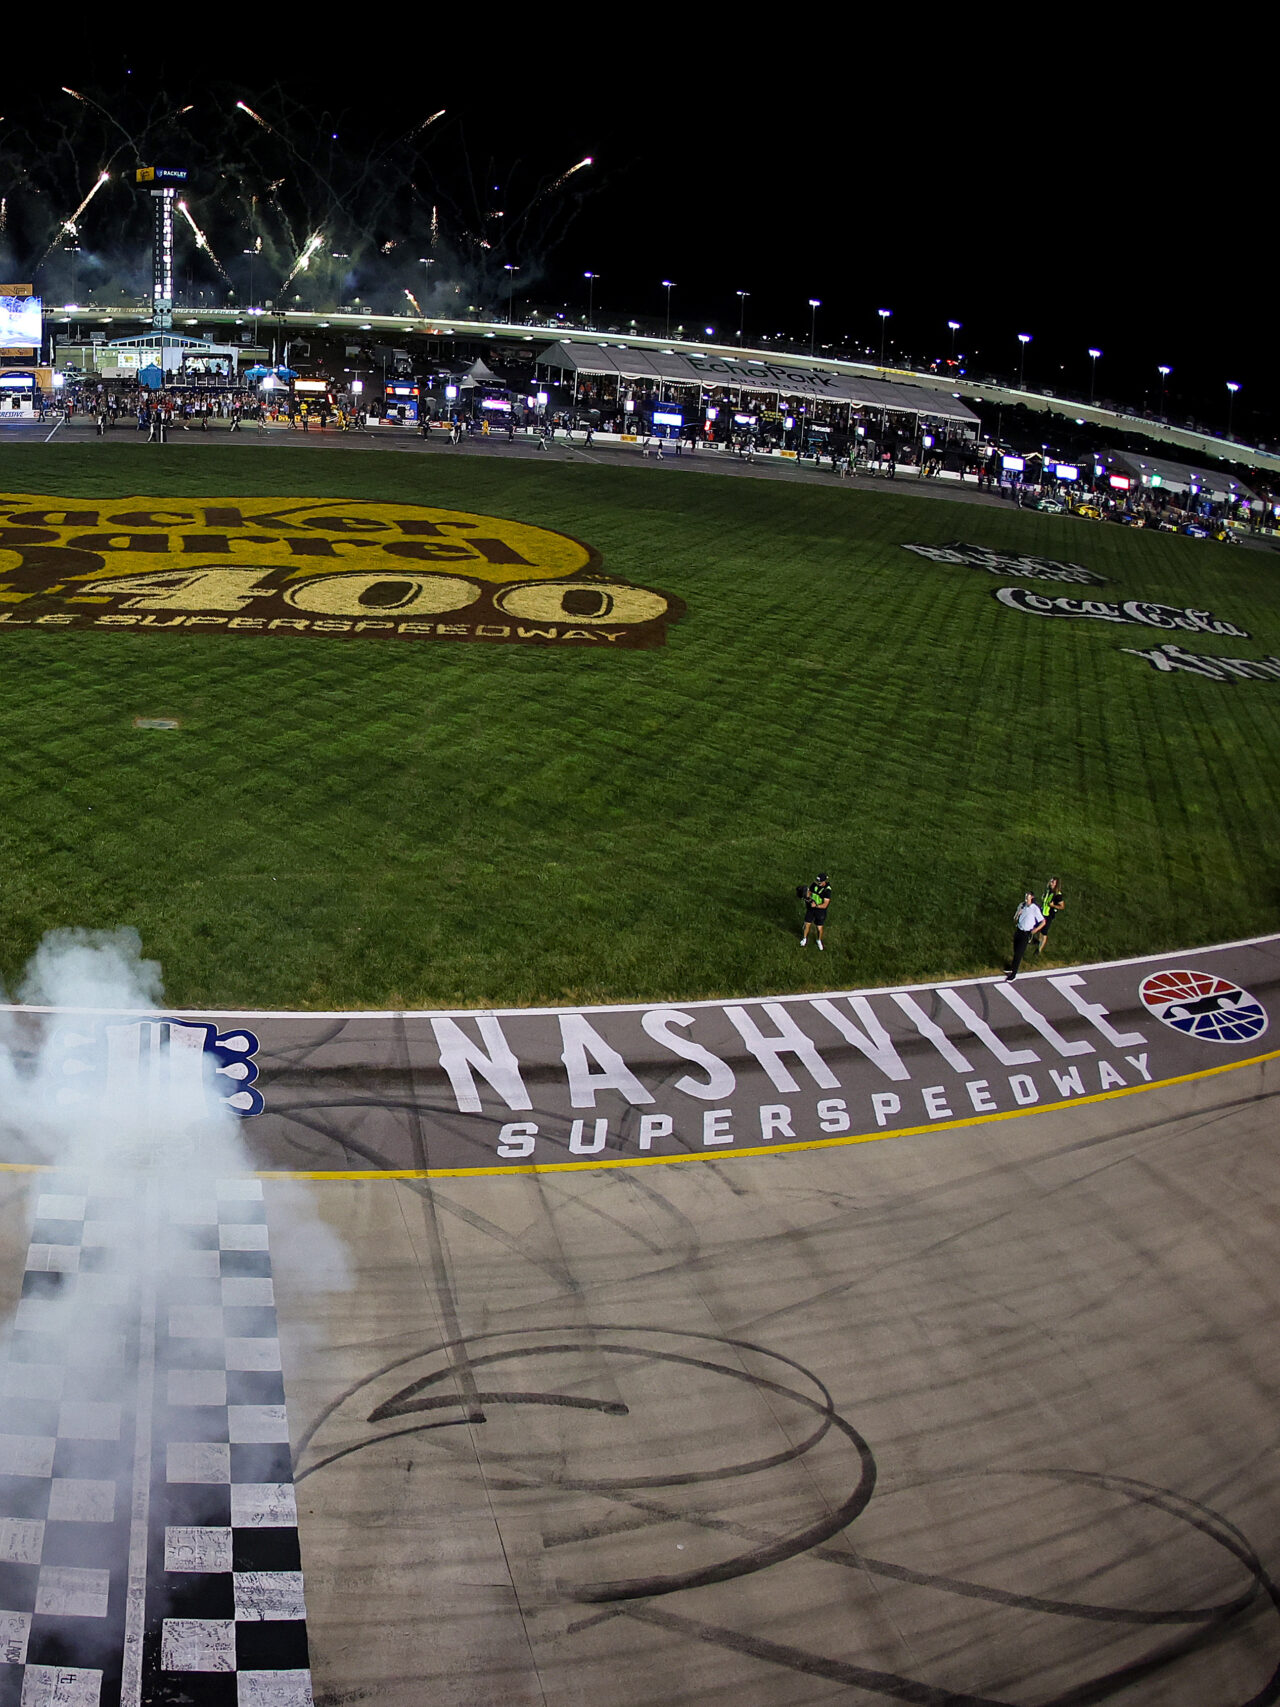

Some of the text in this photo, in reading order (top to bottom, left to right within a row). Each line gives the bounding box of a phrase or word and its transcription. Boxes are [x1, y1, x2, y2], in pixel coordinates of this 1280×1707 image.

[687, 358, 840, 388] EchoPark
[77, 567, 669, 626] 400
[93, 614, 627, 642] SUPERSPEEDWAY
[431, 974, 1149, 1113] NASHVILLE
[496, 1053, 1156, 1159] SUPERSPEEDWAY
